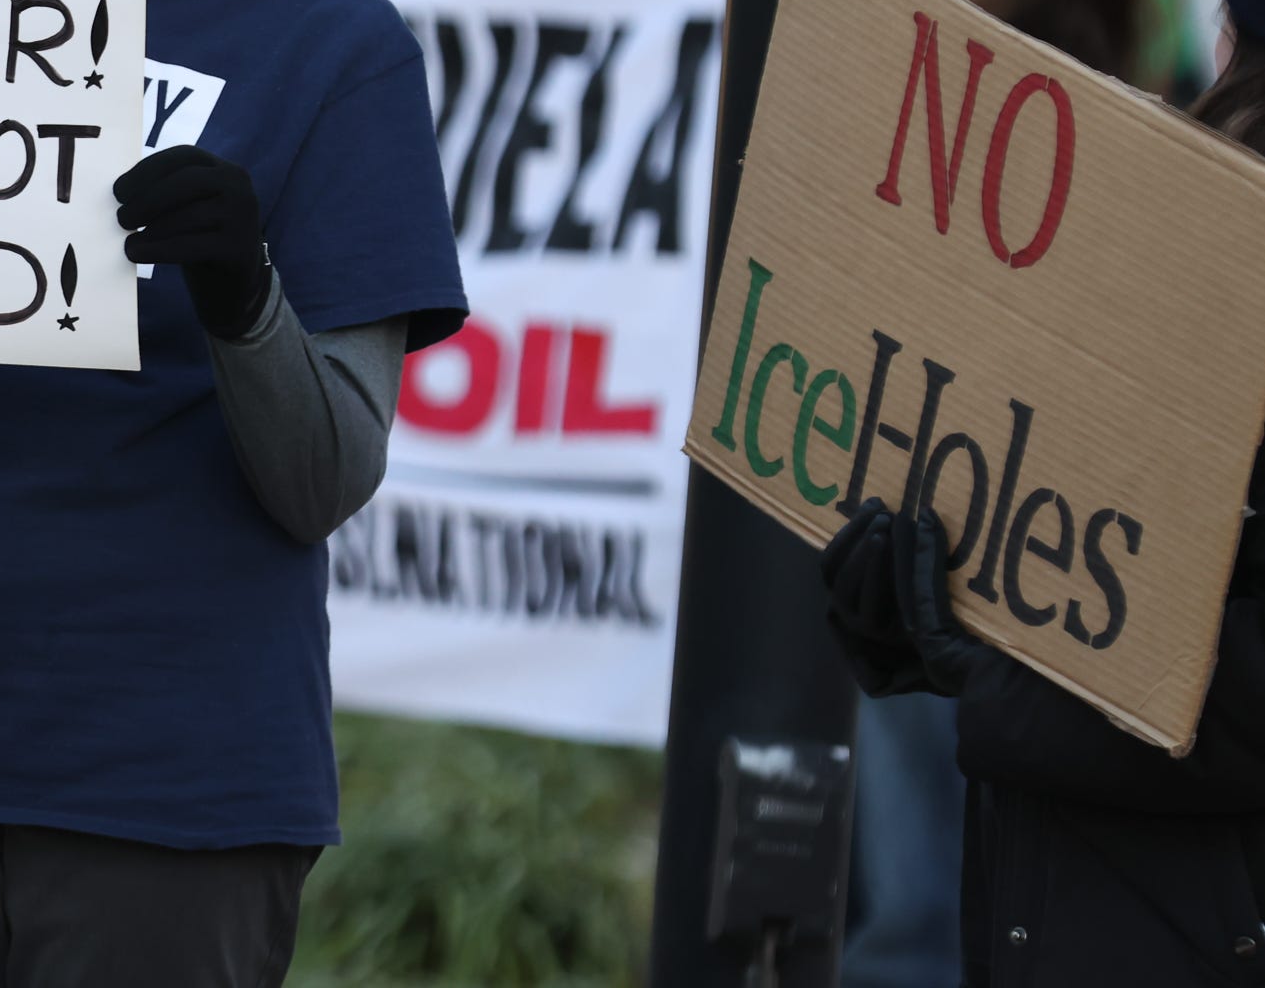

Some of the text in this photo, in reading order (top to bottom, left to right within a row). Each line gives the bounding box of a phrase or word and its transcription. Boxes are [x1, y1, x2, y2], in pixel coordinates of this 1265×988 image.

[143, 75, 195, 149] Y
[404, 14, 716, 255] UELA
[875, 10, 1077, 270] NO
[397, 317, 660, 437] OIL
[711, 256, 1144, 651] IceHoles
